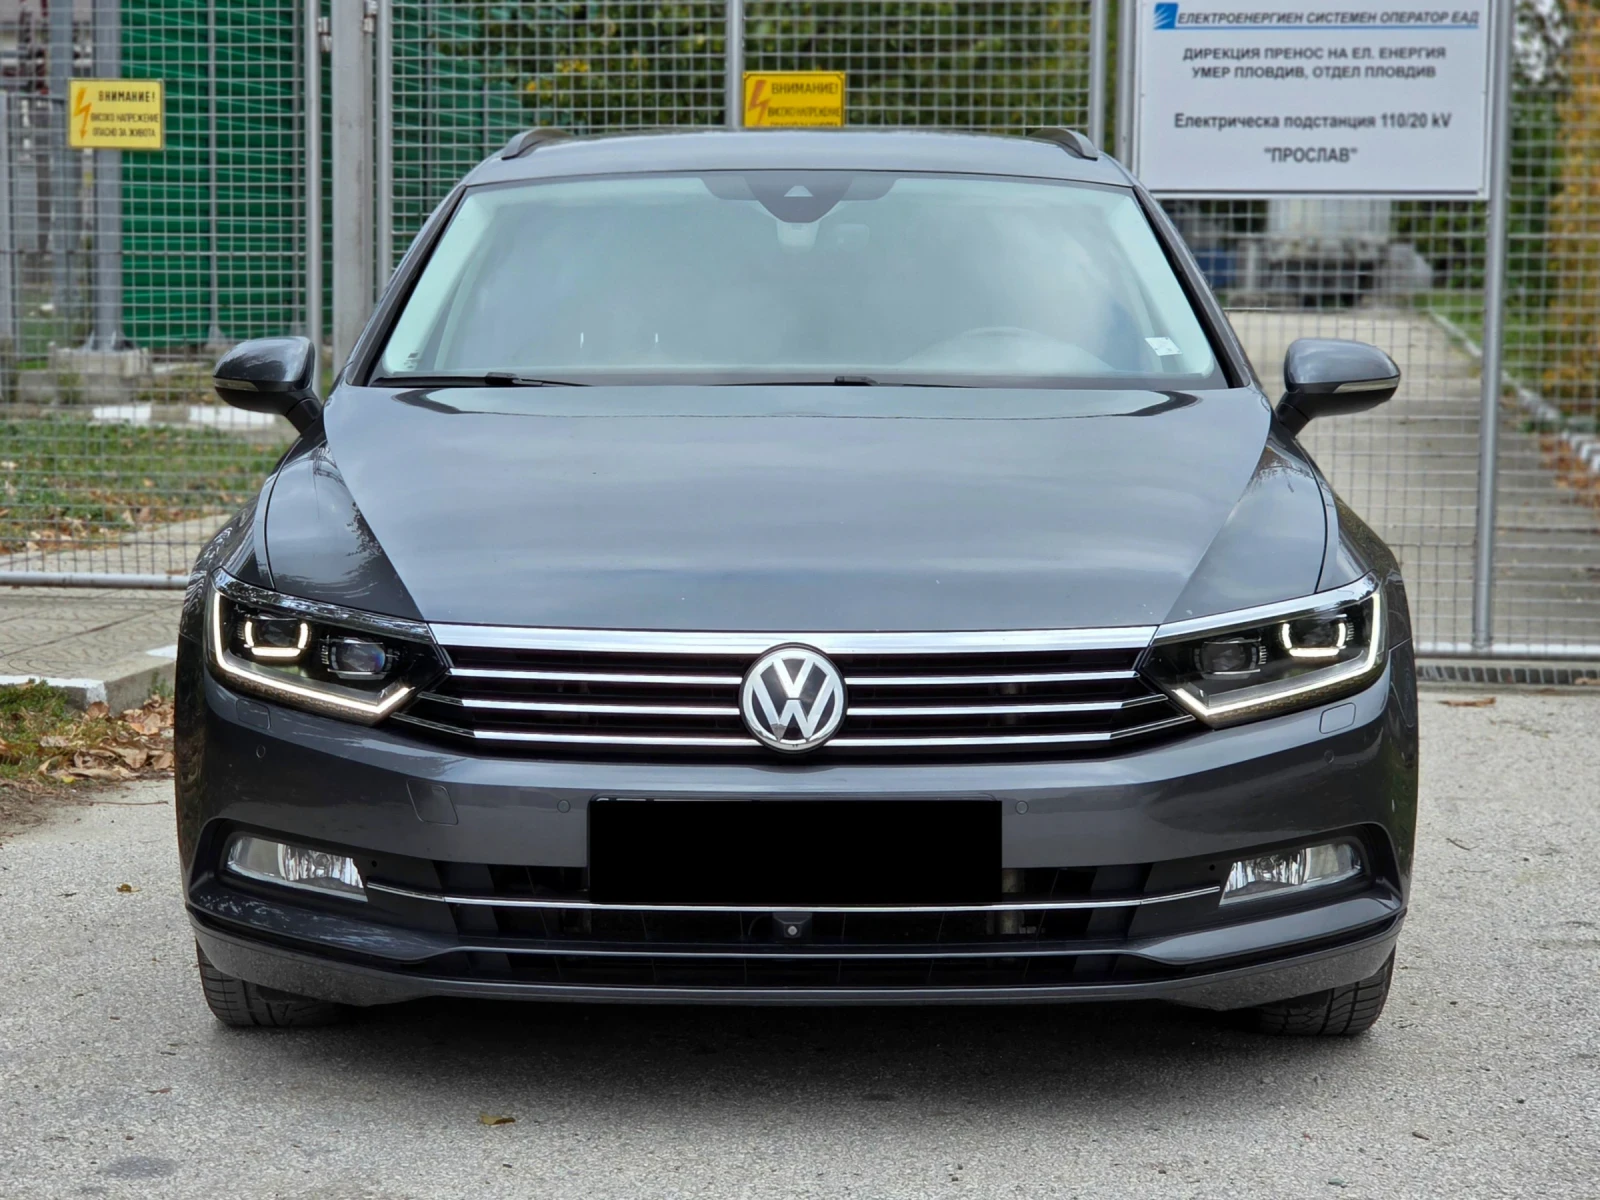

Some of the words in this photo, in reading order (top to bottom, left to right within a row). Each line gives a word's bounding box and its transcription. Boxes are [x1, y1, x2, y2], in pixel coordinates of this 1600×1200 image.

[1177, 12, 1303, 24] ЕЛЕКТРОЕНЕРГИЕН
[1306, 12, 1376, 24] СИСТЕМЕН
[1380, 11, 1449, 24] ОПЕРАТОР
[1451, 11, 1479, 24] ЕАД
[1182, 47, 1261, 61] ДИРЕКЦИЯ
[1264, 47, 1324, 60] ПРЕНОС
[1328, 47, 1348, 60] НА
[1352, 47, 1374, 60] ЕЛ.
[1379, 47, 1446, 60] ЕНЕРГИЯ
[1192, 66, 1230, 79] УМЕР
[1234, 66, 1309, 80] ПЛОВДИВ,
[1312, 66, 1360, 80] ОТДЕЛ
[1364, 66, 1436, 80] ПЛОВДИВ
[771, 82, 838, 95] ВНИМАНИЕ!
[1174, 112, 1280, 131] Електрическа
[1284, 115, 1376, 130] подстанция
[1381, 112, 1428, 128] 110/20
[1431, 112, 1452, 128] kV
[1264, 147, 1358, 163] "ПРОСЛАВ"
[746, 651, 841, 747] VW
